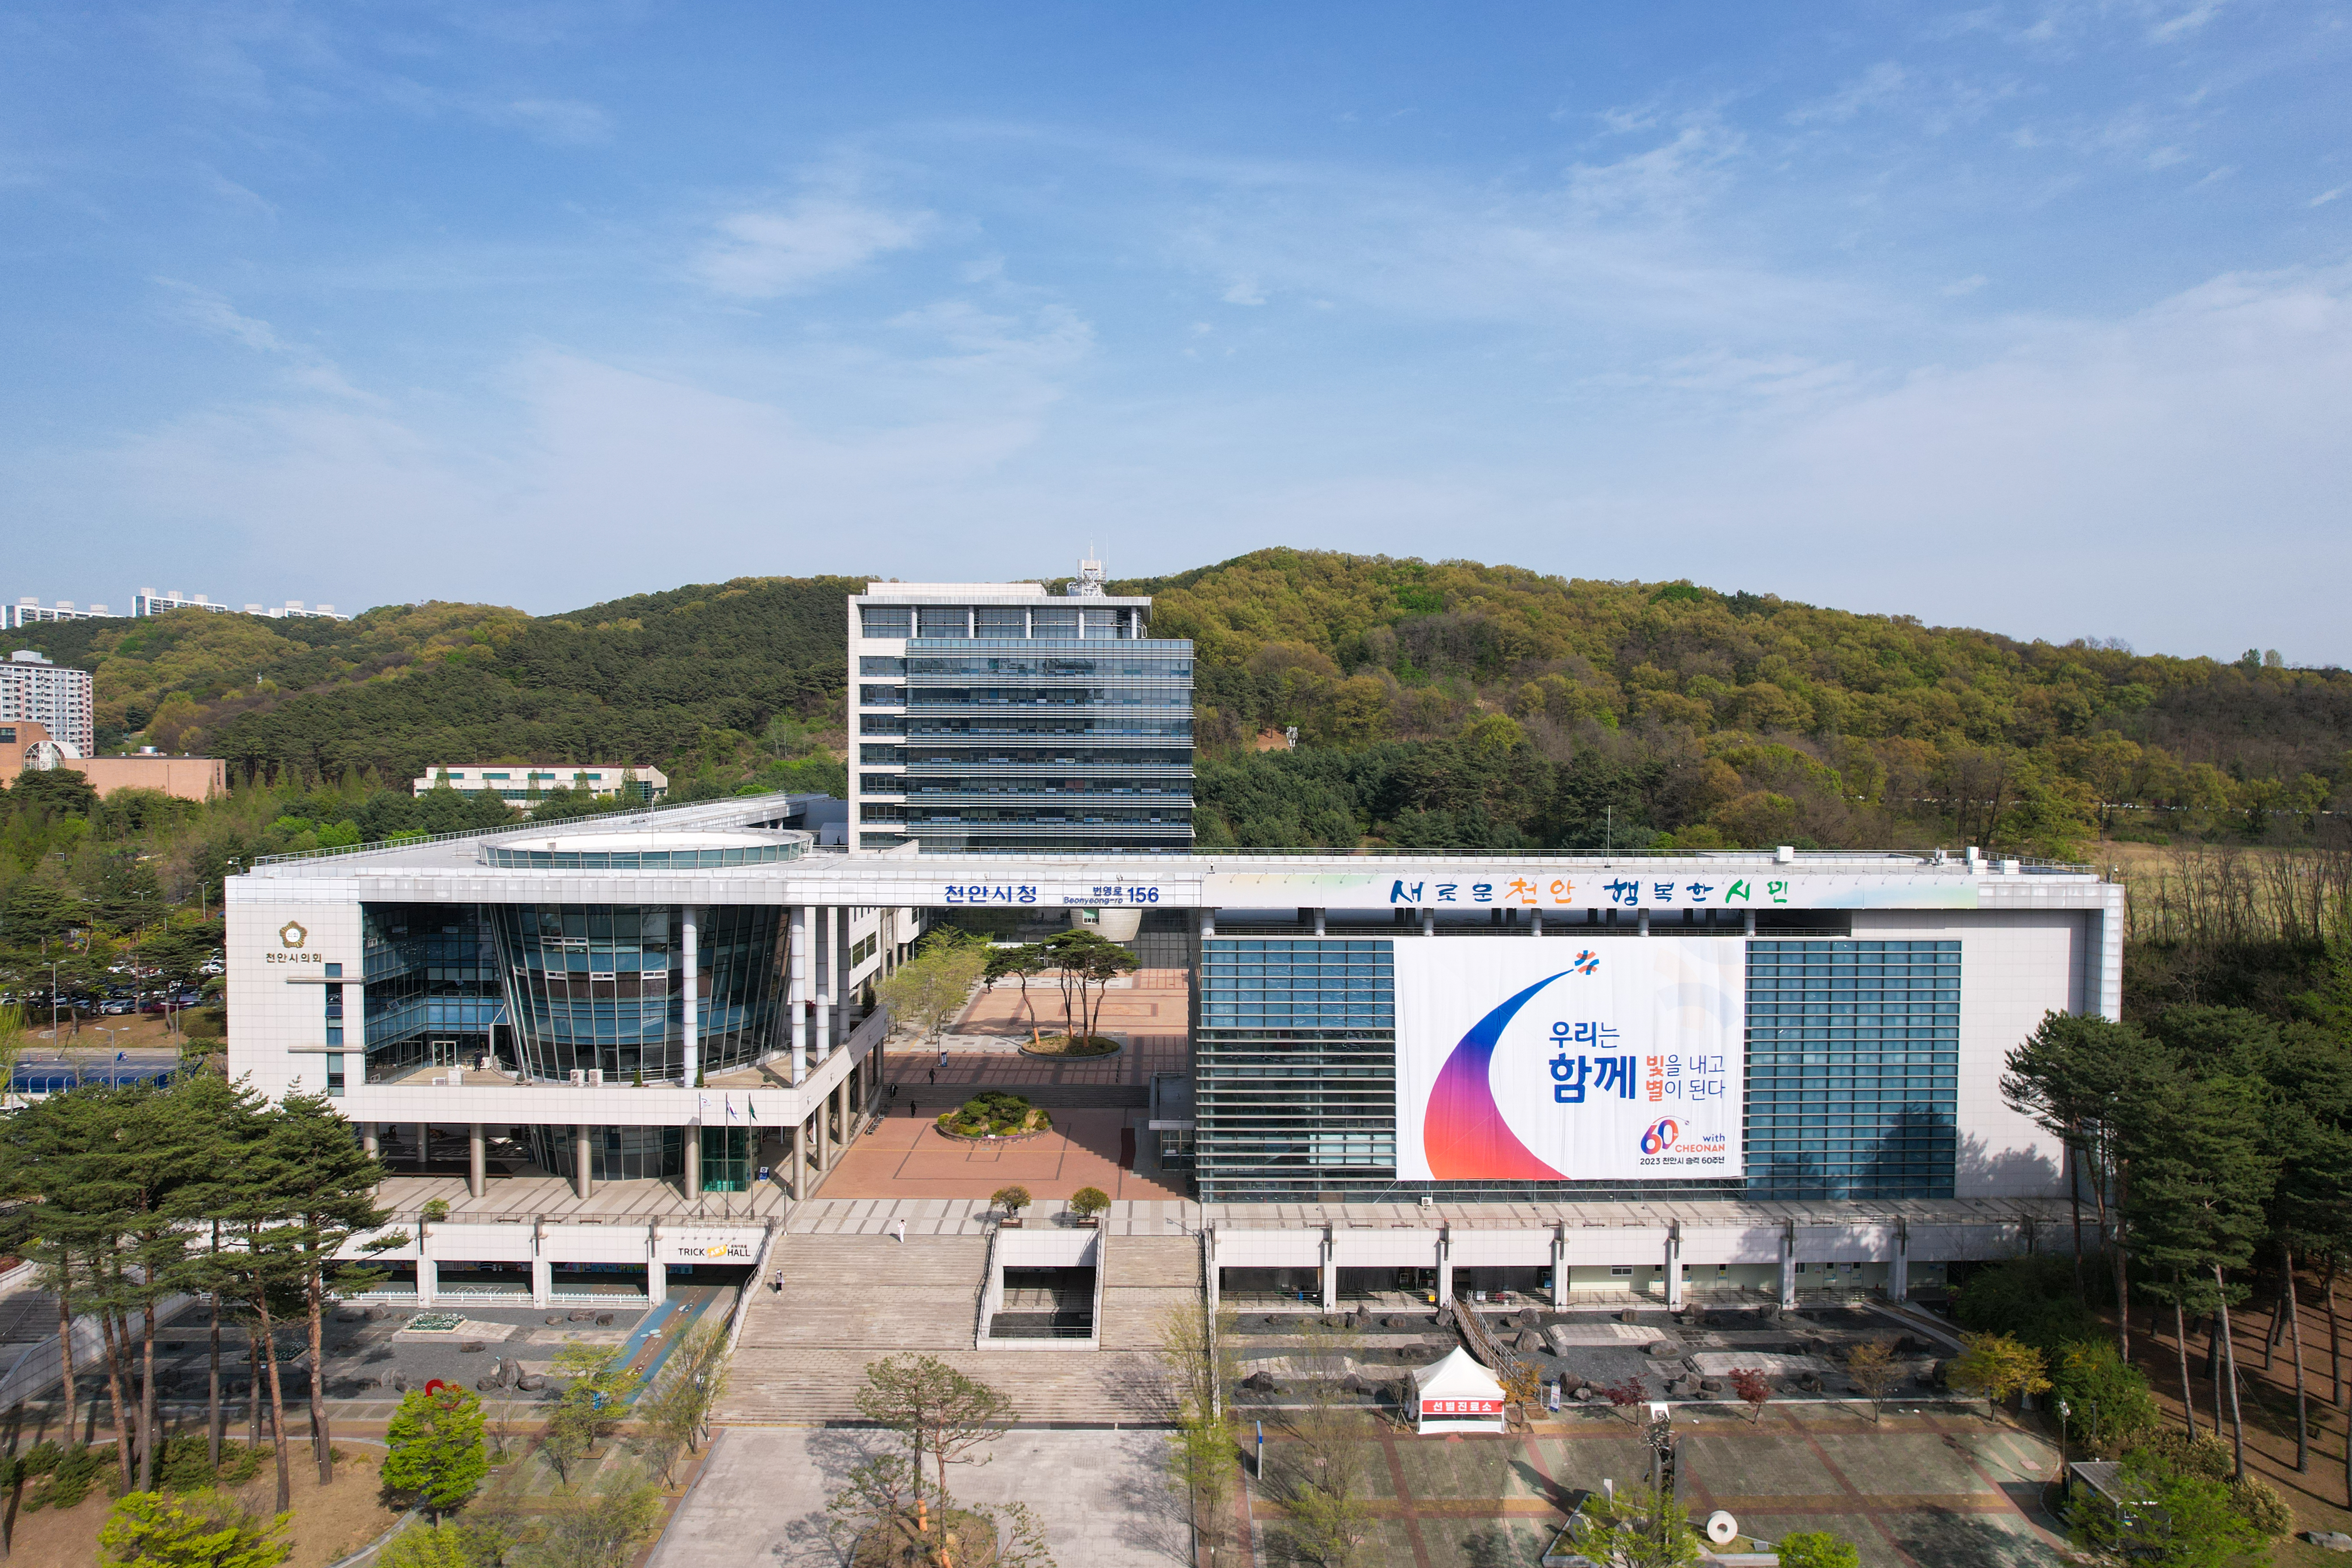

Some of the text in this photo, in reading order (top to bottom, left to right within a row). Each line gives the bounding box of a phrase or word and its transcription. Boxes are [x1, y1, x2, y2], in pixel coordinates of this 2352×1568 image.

[944, 885, 1037, 903] 천안시청
[1093, 886, 1123, 896] 번영로
[1127, 887, 1159, 903] 156
[1064, 896, 1124, 905] Beonyeong-ro
[266, 953, 321, 963] 천안시의회
[1549, 1021, 1620, 1049] 우리는
[1646, 1054, 1725, 1077] 빛을 내고
[1549, 1053, 1636, 1103] 함께
[1646, 1079, 1726, 1102] 별이 된다
[1703, 1133, 1725, 1142] with
[1675, 1144, 1725, 1153] CHEONAN
[710, 1246, 724, 1256] ART
[1433, 1401, 1492, 1412] 선별진료소
